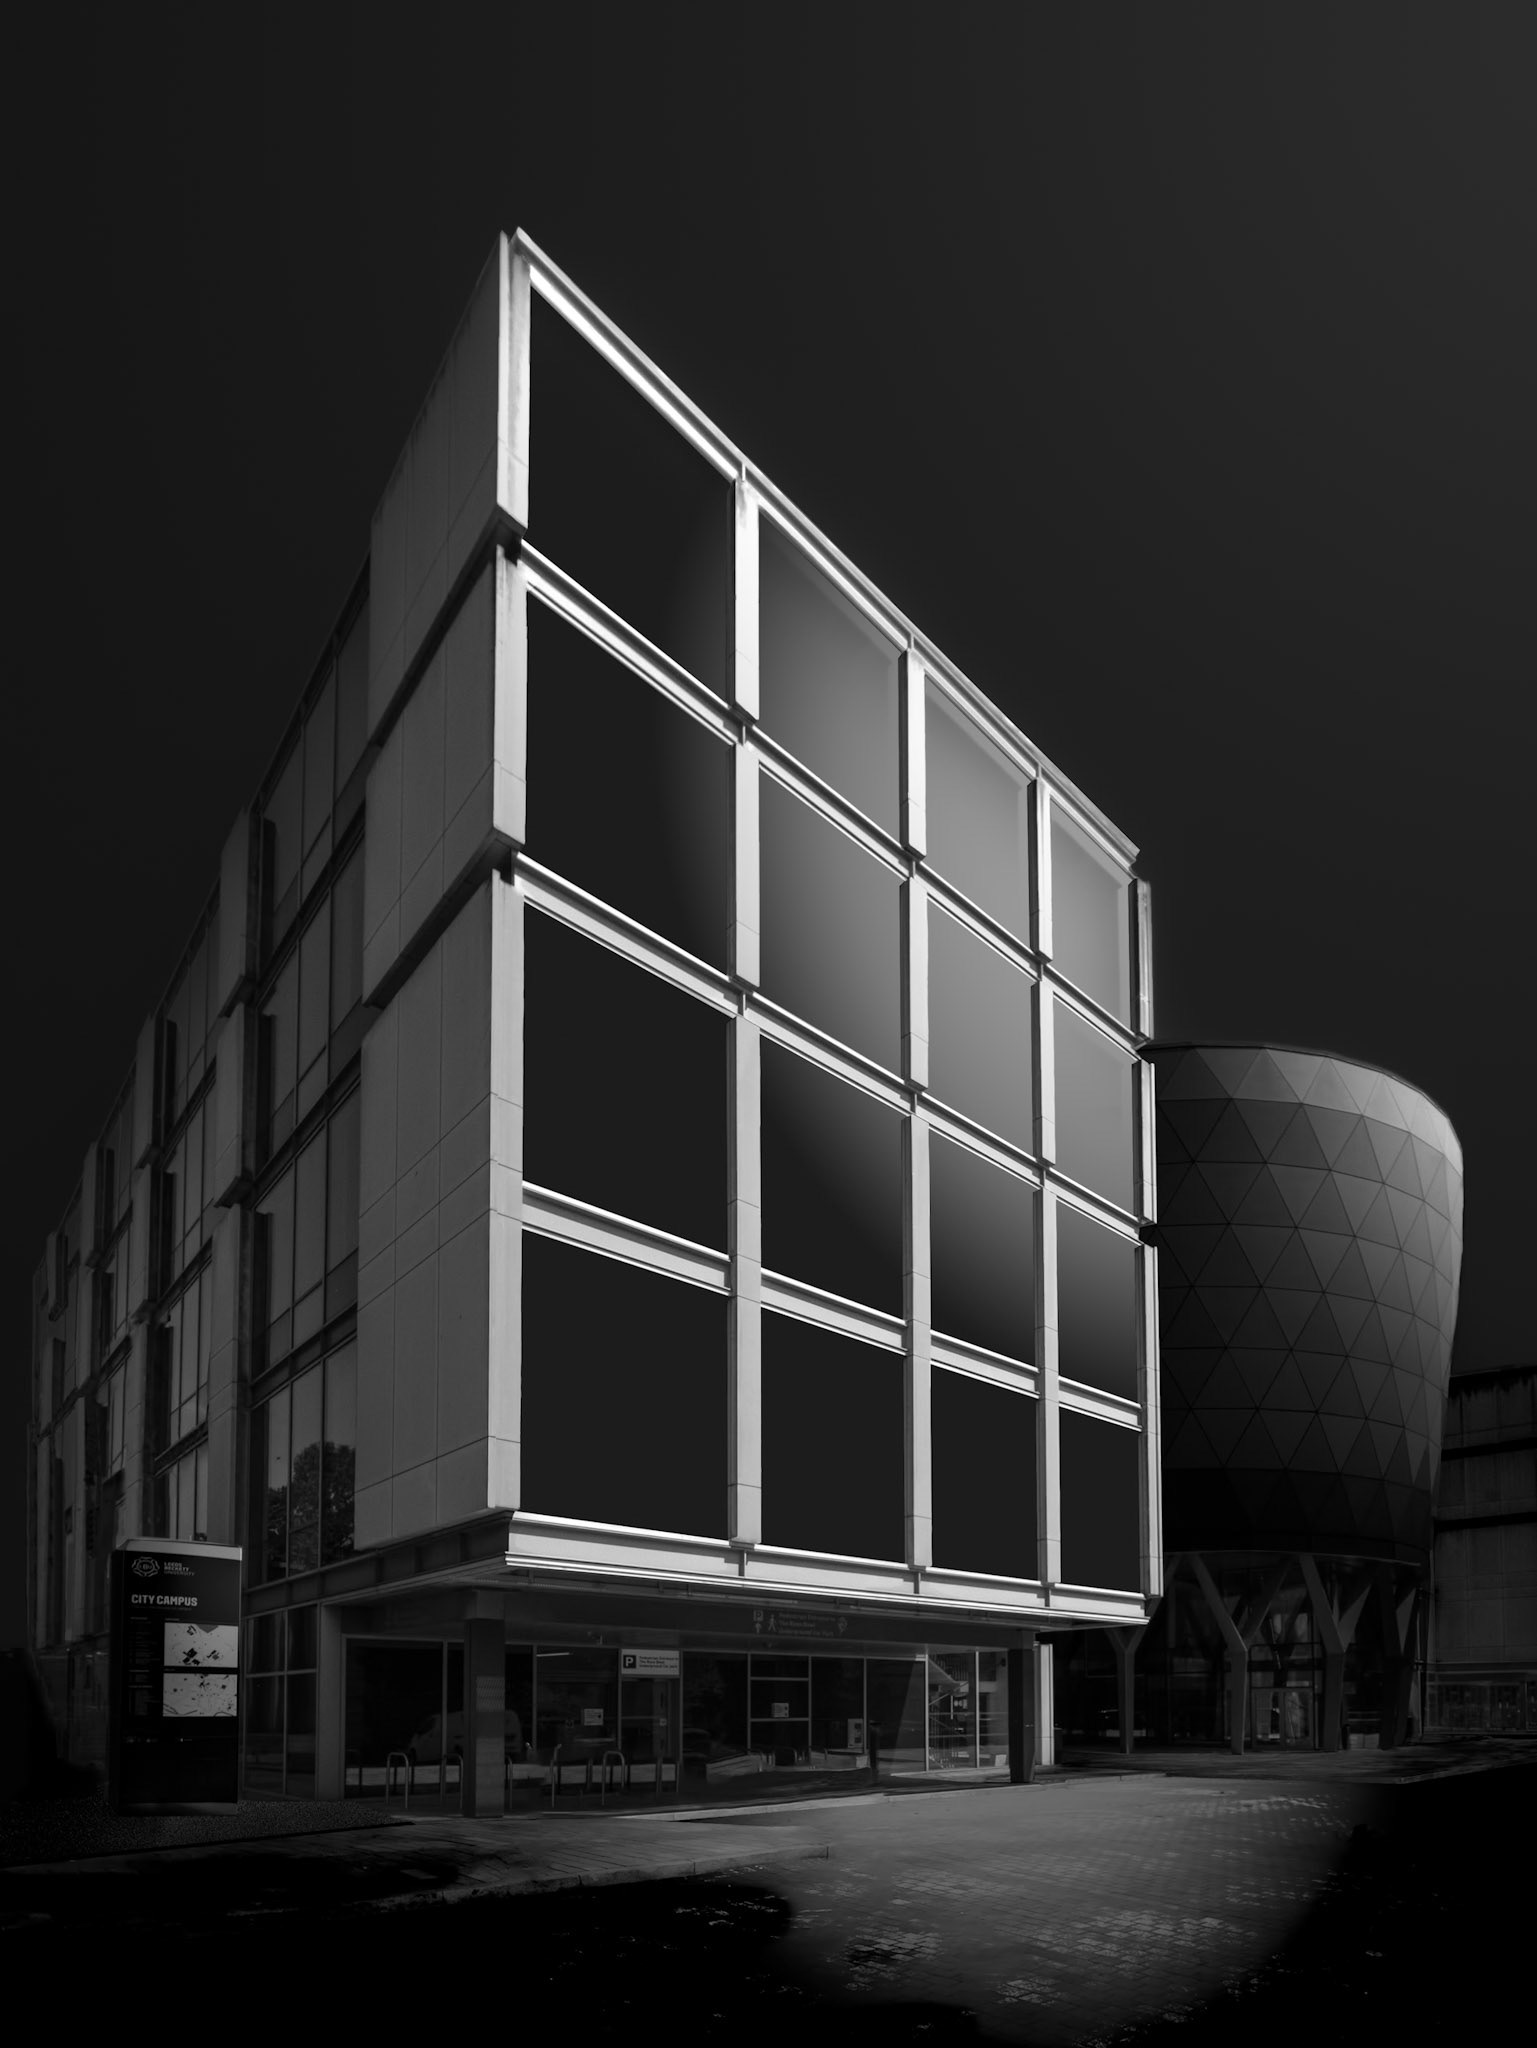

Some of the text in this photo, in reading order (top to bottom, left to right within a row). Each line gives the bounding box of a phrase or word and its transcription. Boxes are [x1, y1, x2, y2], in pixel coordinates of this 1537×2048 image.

[131, 1594, 198, 1607] CITY CAMPUS
[625, 1656, 634, 1667] P
